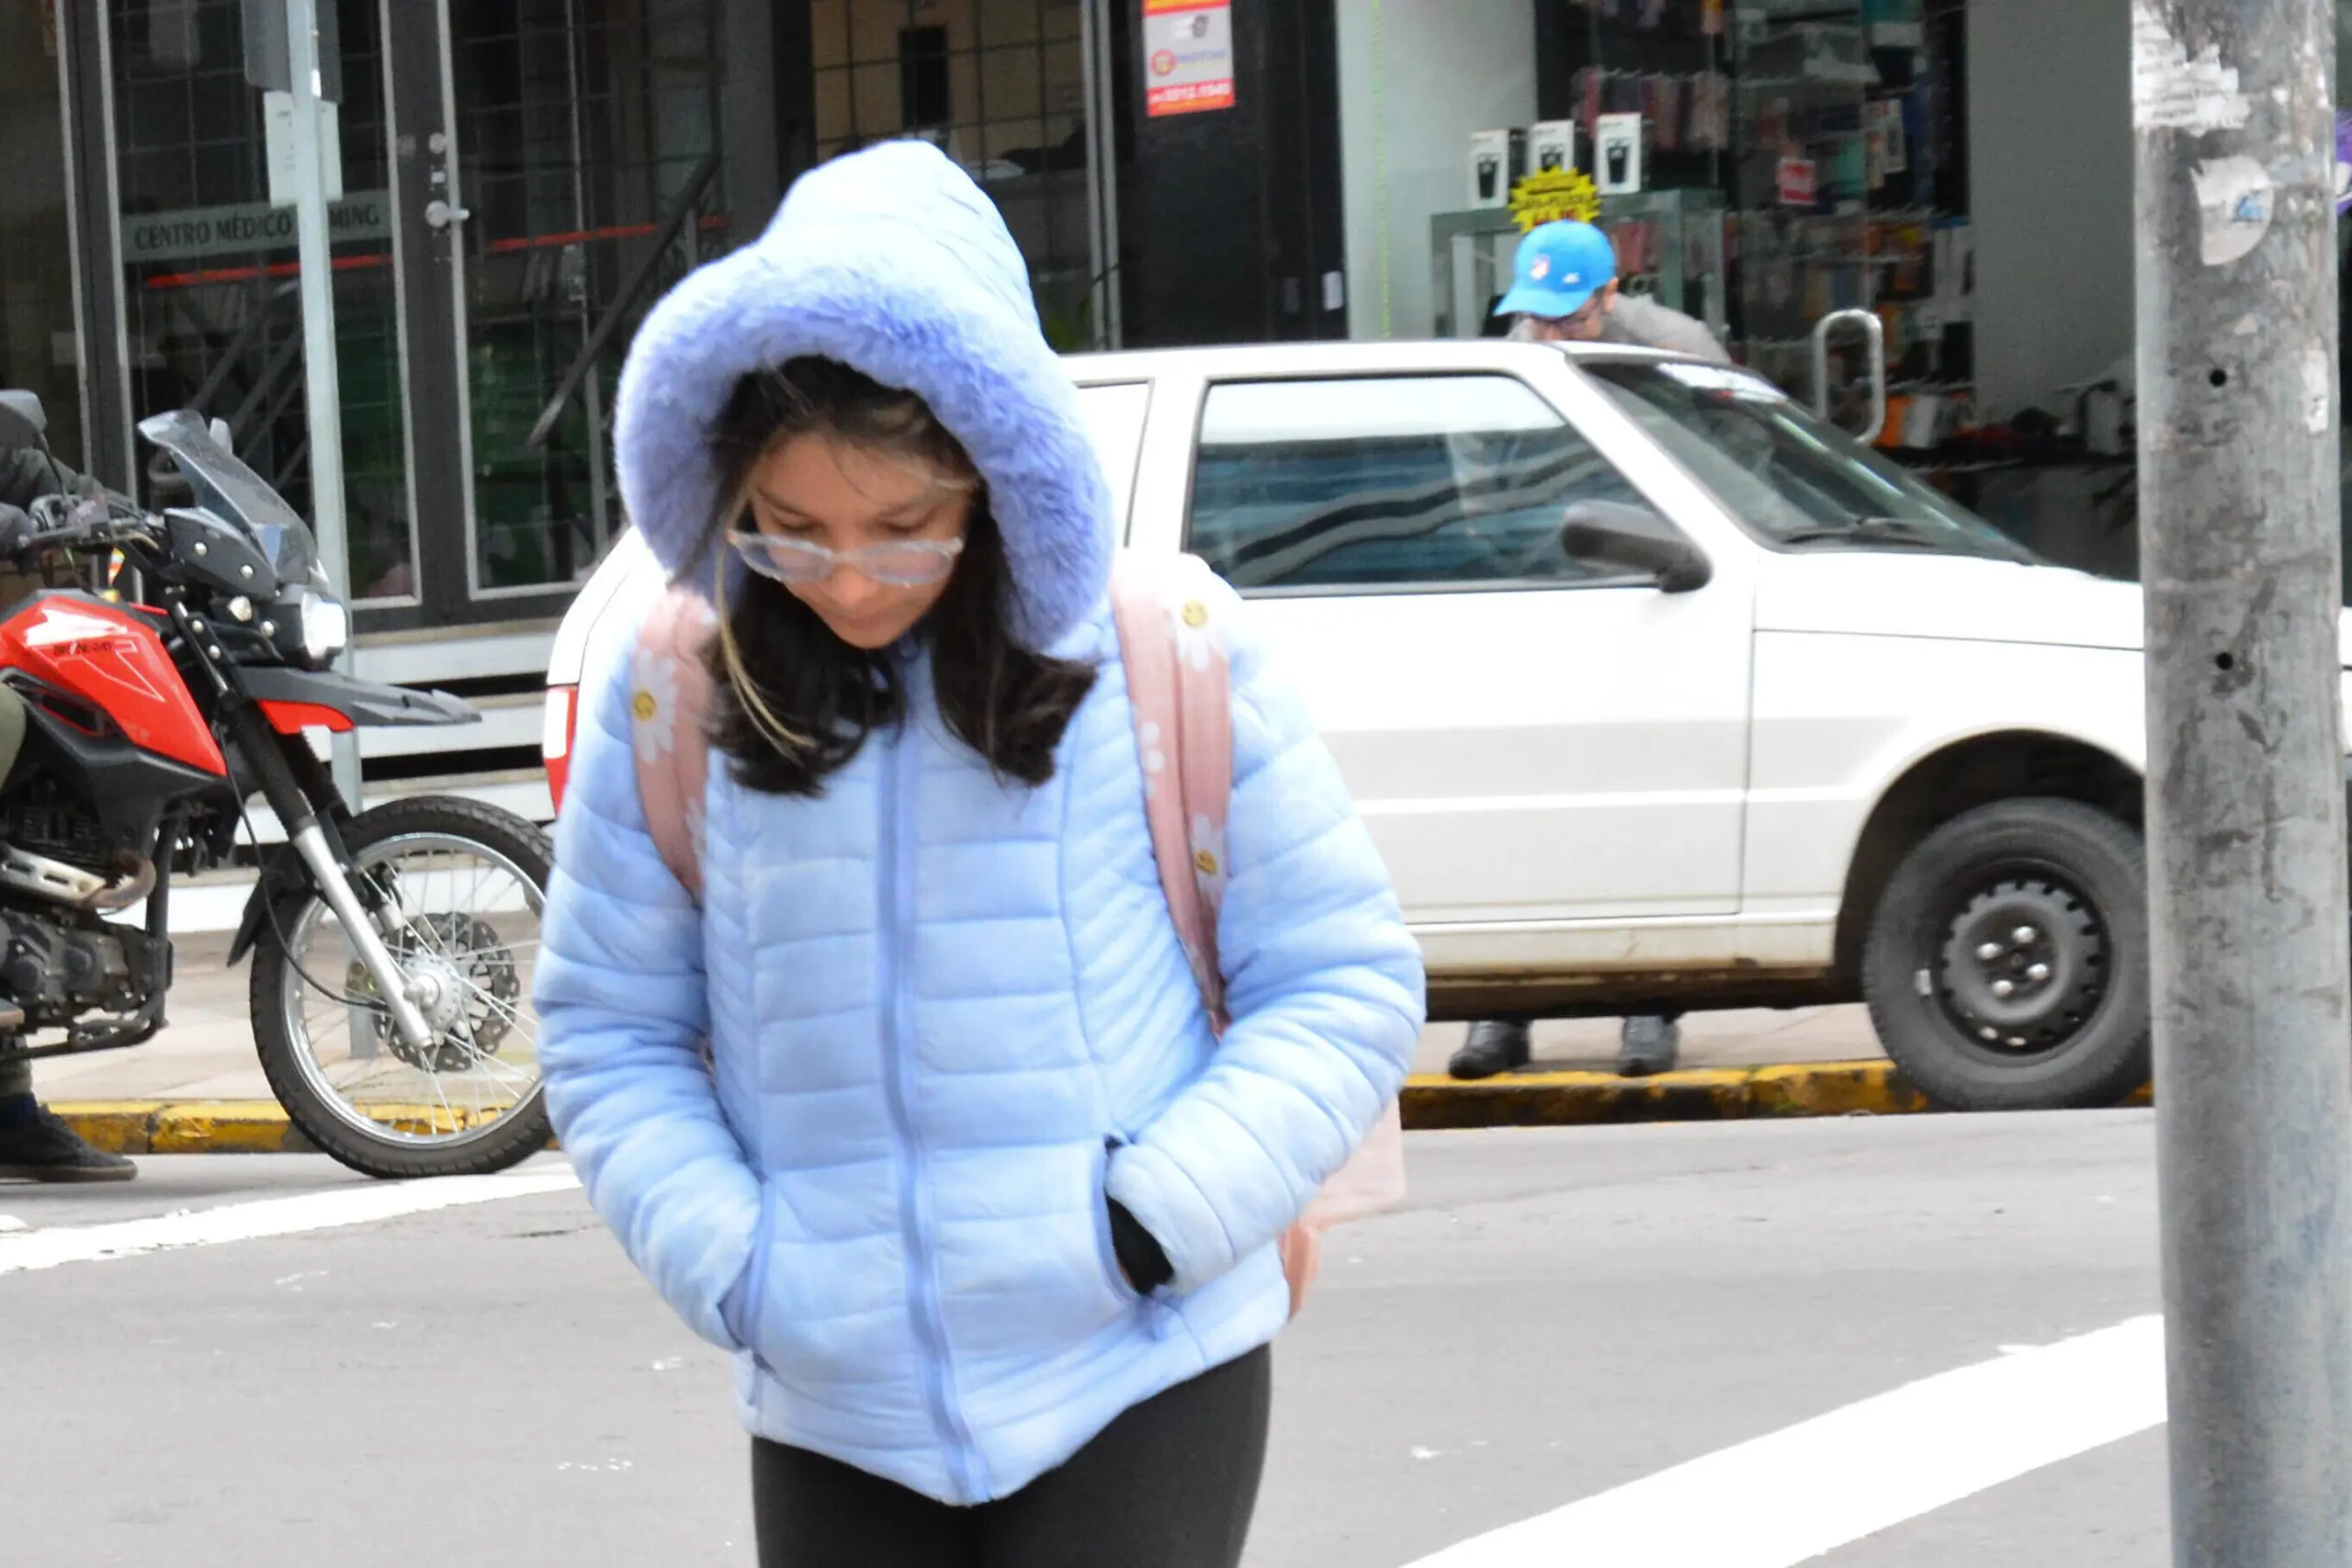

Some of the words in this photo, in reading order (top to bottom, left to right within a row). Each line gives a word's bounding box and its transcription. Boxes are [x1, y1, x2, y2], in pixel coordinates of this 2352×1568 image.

[134, 219, 211, 251] CENTRO
[216, 211, 292, 243] MÉDICO
[329, 203, 380, 229] MING
